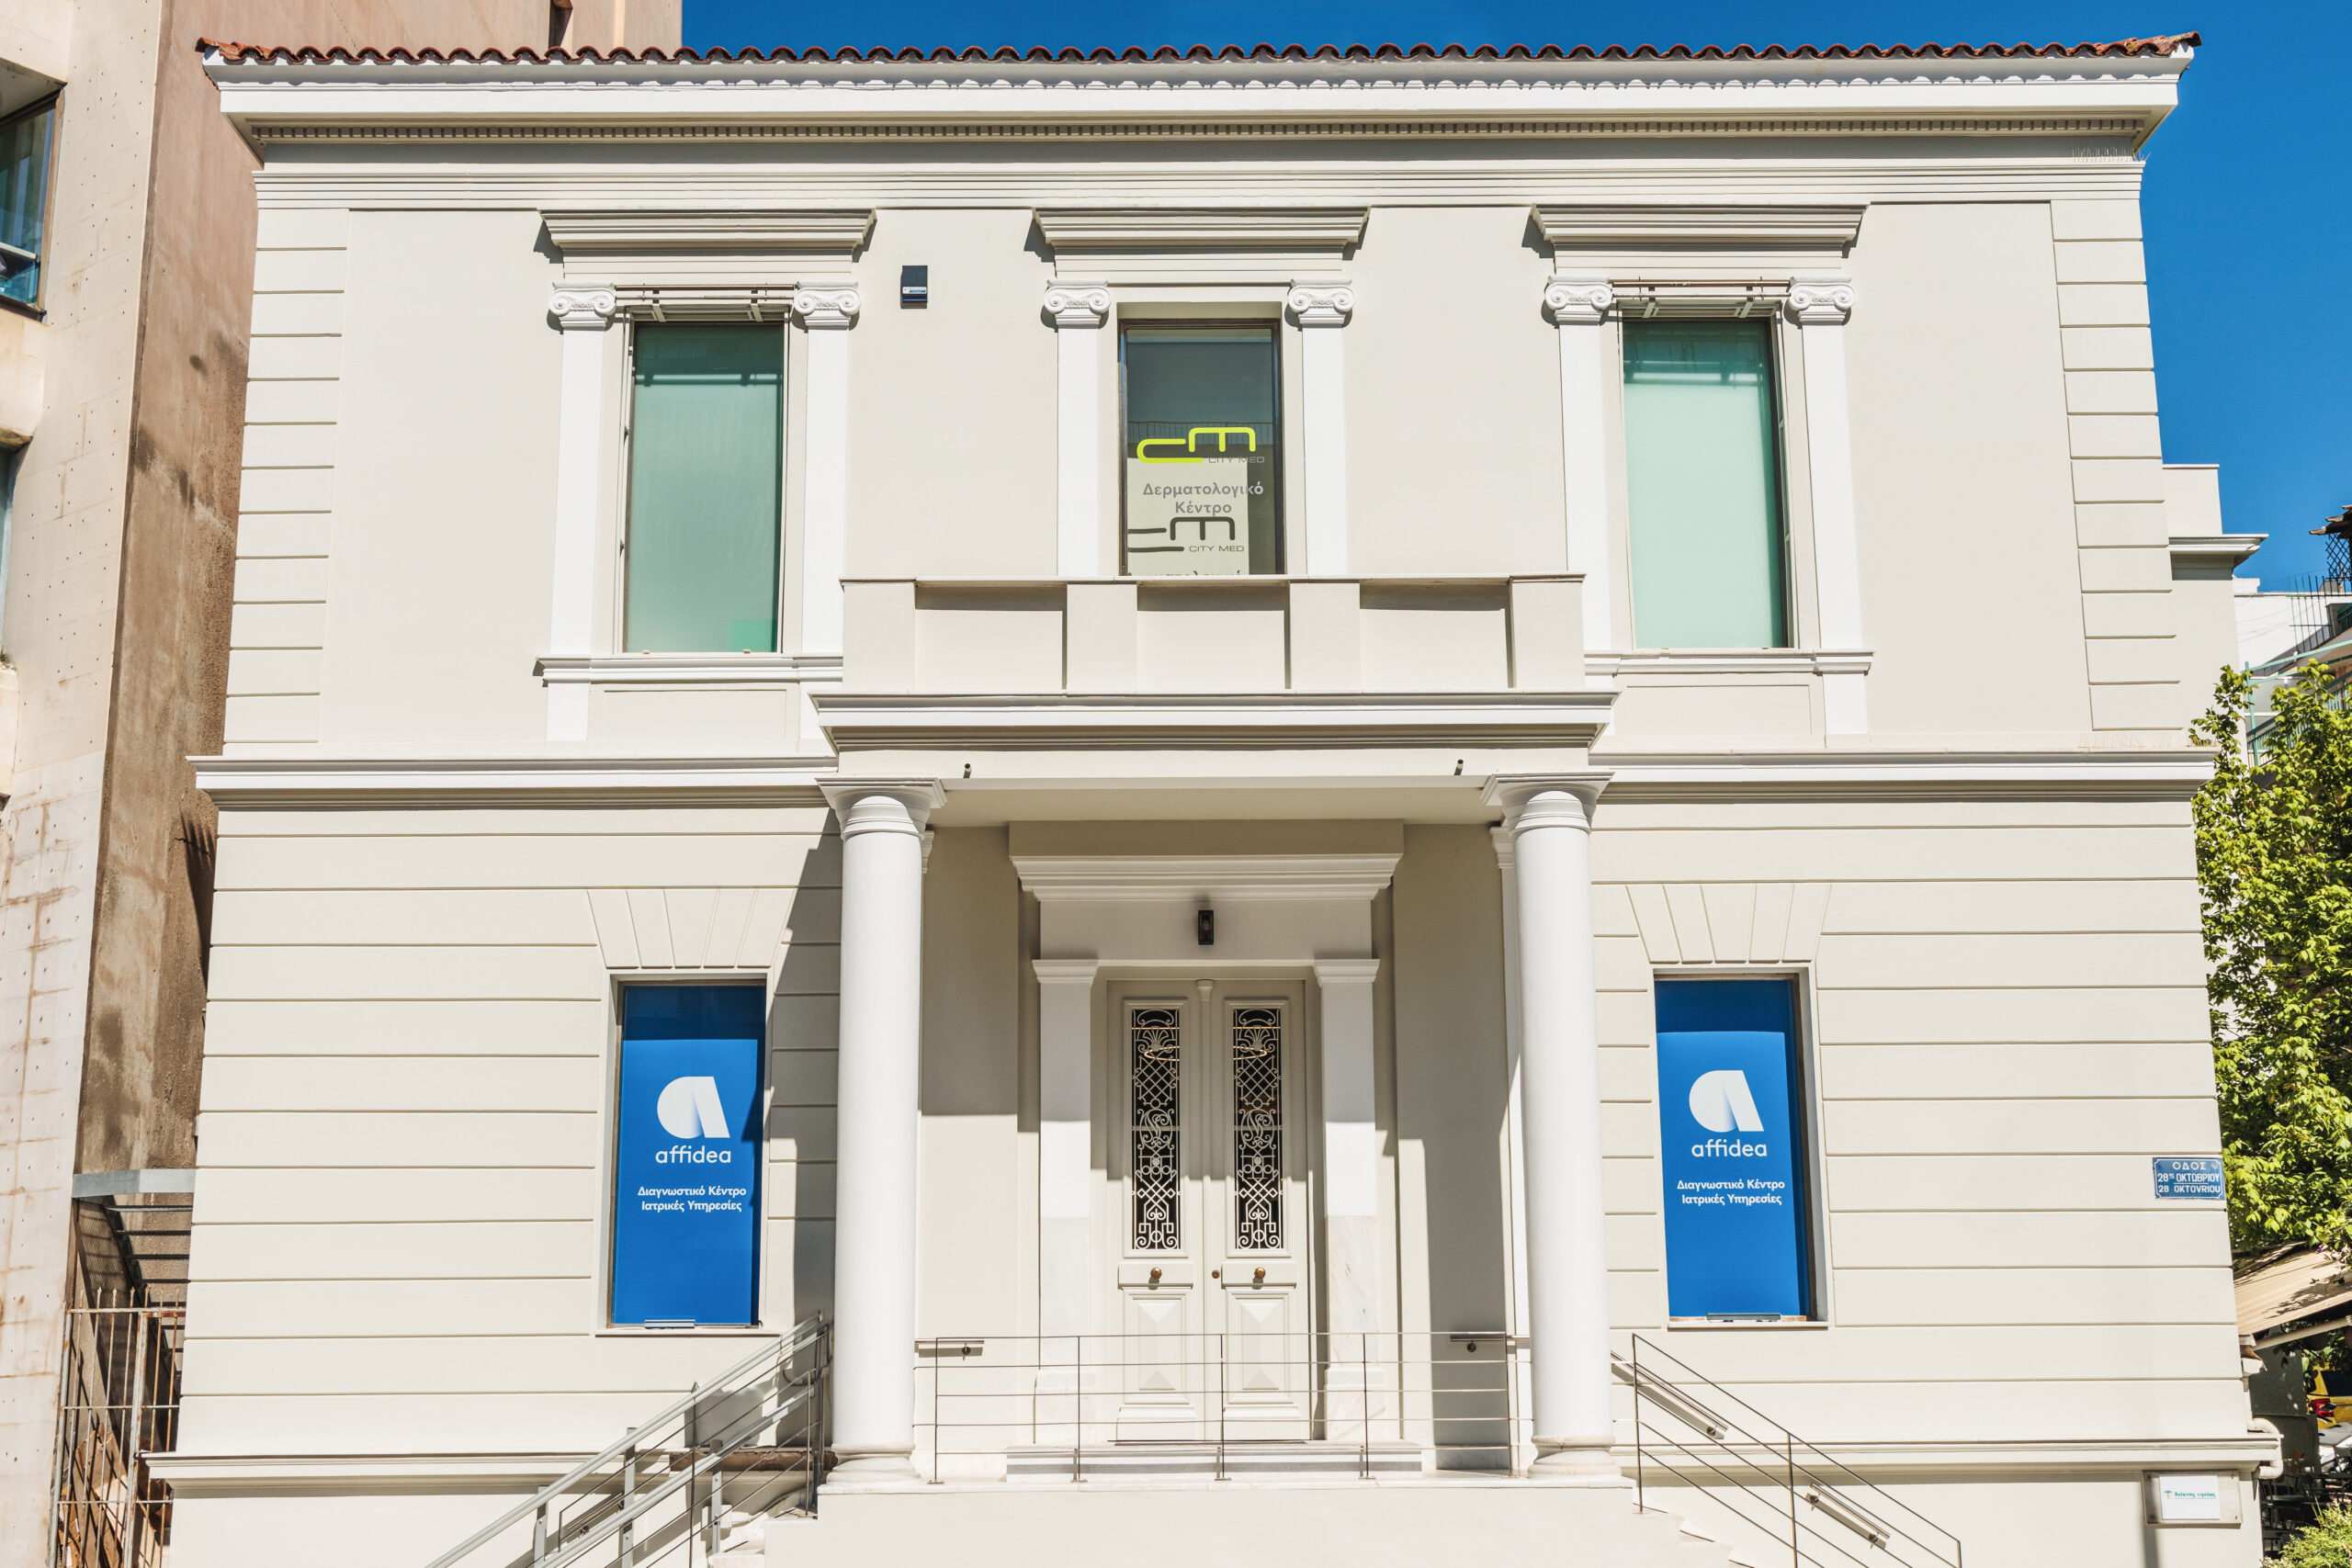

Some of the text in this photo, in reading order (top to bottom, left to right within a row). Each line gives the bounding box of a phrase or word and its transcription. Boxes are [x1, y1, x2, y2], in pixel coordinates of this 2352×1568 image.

[1143, 481, 1264, 498] Δερματολογικό
[1175, 501, 1232, 517] Κέντρο
[1691, 1138, 1768, 1157] affidea
[655, 1145, 731, 1164] affidea
[2176, 1173, 2220, 1183] ΟΚΤΩΒΡΙΟΥ
[638, 1185, 747, 1199] Διαγνωστικό Κέντρο
[1677, 1179, 1785, 1192] Διαγνωστικό Κέντρο
[2158, 1185, 2221, 1193] 28 OKTOVRIOU
[1681, 1193, 1782, 1206] Ιατρικές Υπηρεσίες
[641, 1200, 742, 1213] Ιατρικές Υπηρεσίες
